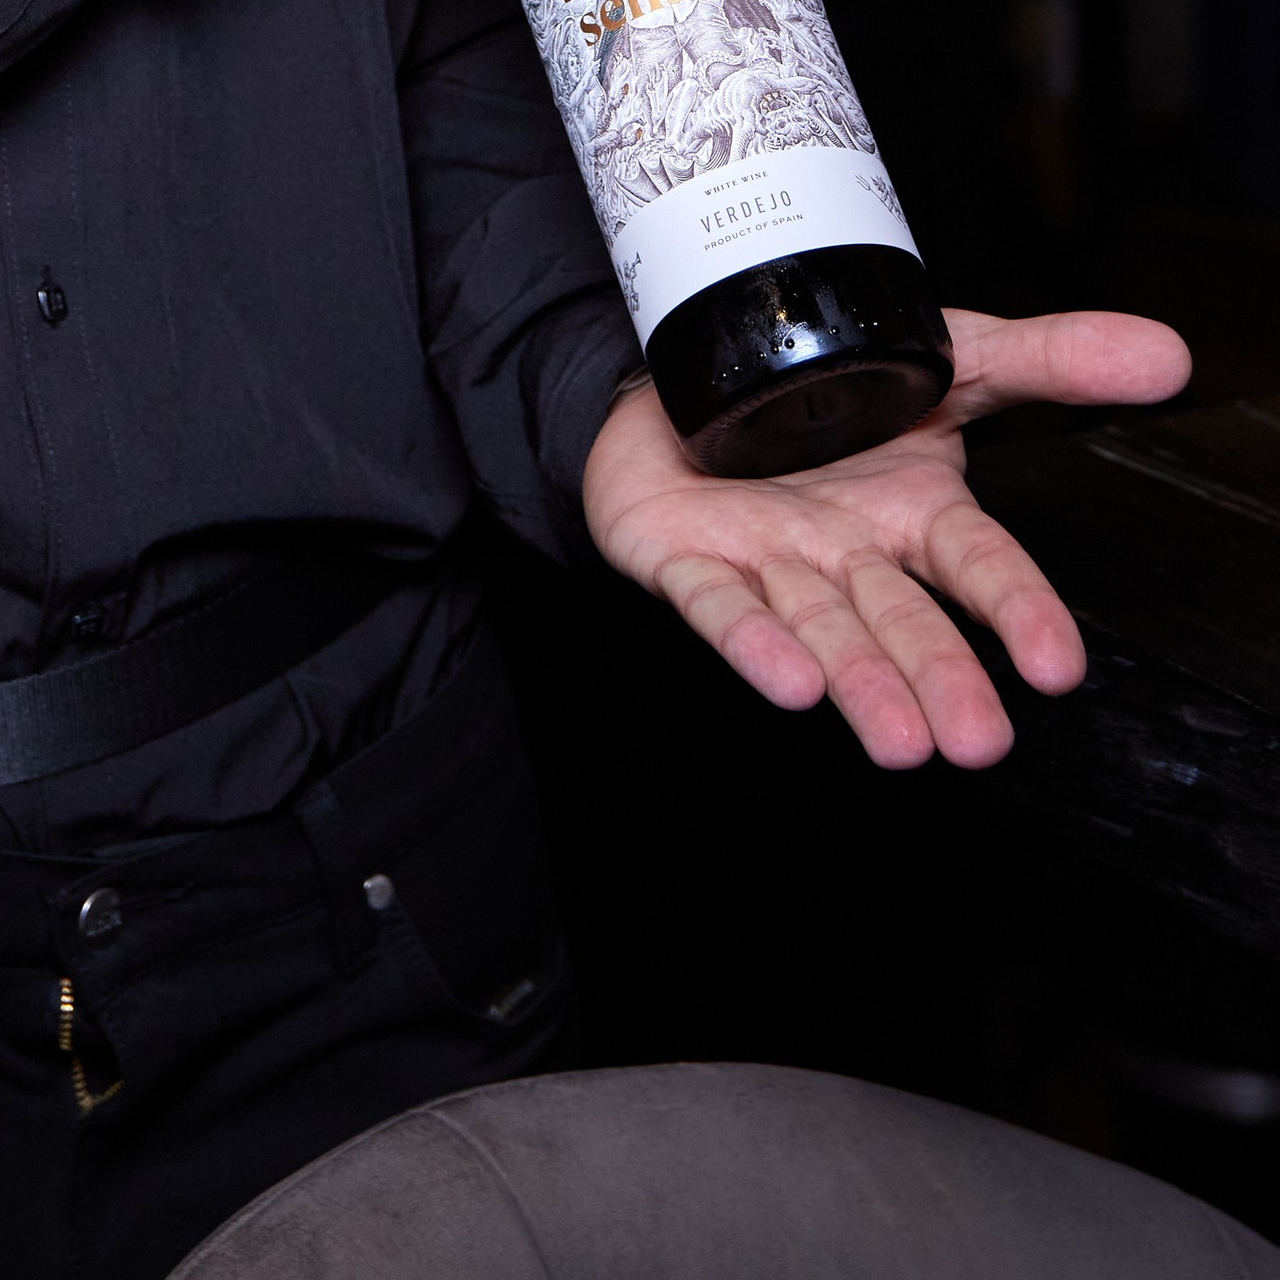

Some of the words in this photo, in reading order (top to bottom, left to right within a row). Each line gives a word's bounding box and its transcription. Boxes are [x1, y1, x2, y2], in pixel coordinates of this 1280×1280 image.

[704, 179, 738, 196] WHITE
[741, 170, 769, 183] WINE
[700, 190, 792, 233] VERDEJO
[704, 226, 752, 251] PRODUCT
[755, 221, 769, 231] OF
[772, 213, 804, 226] SPAIN
